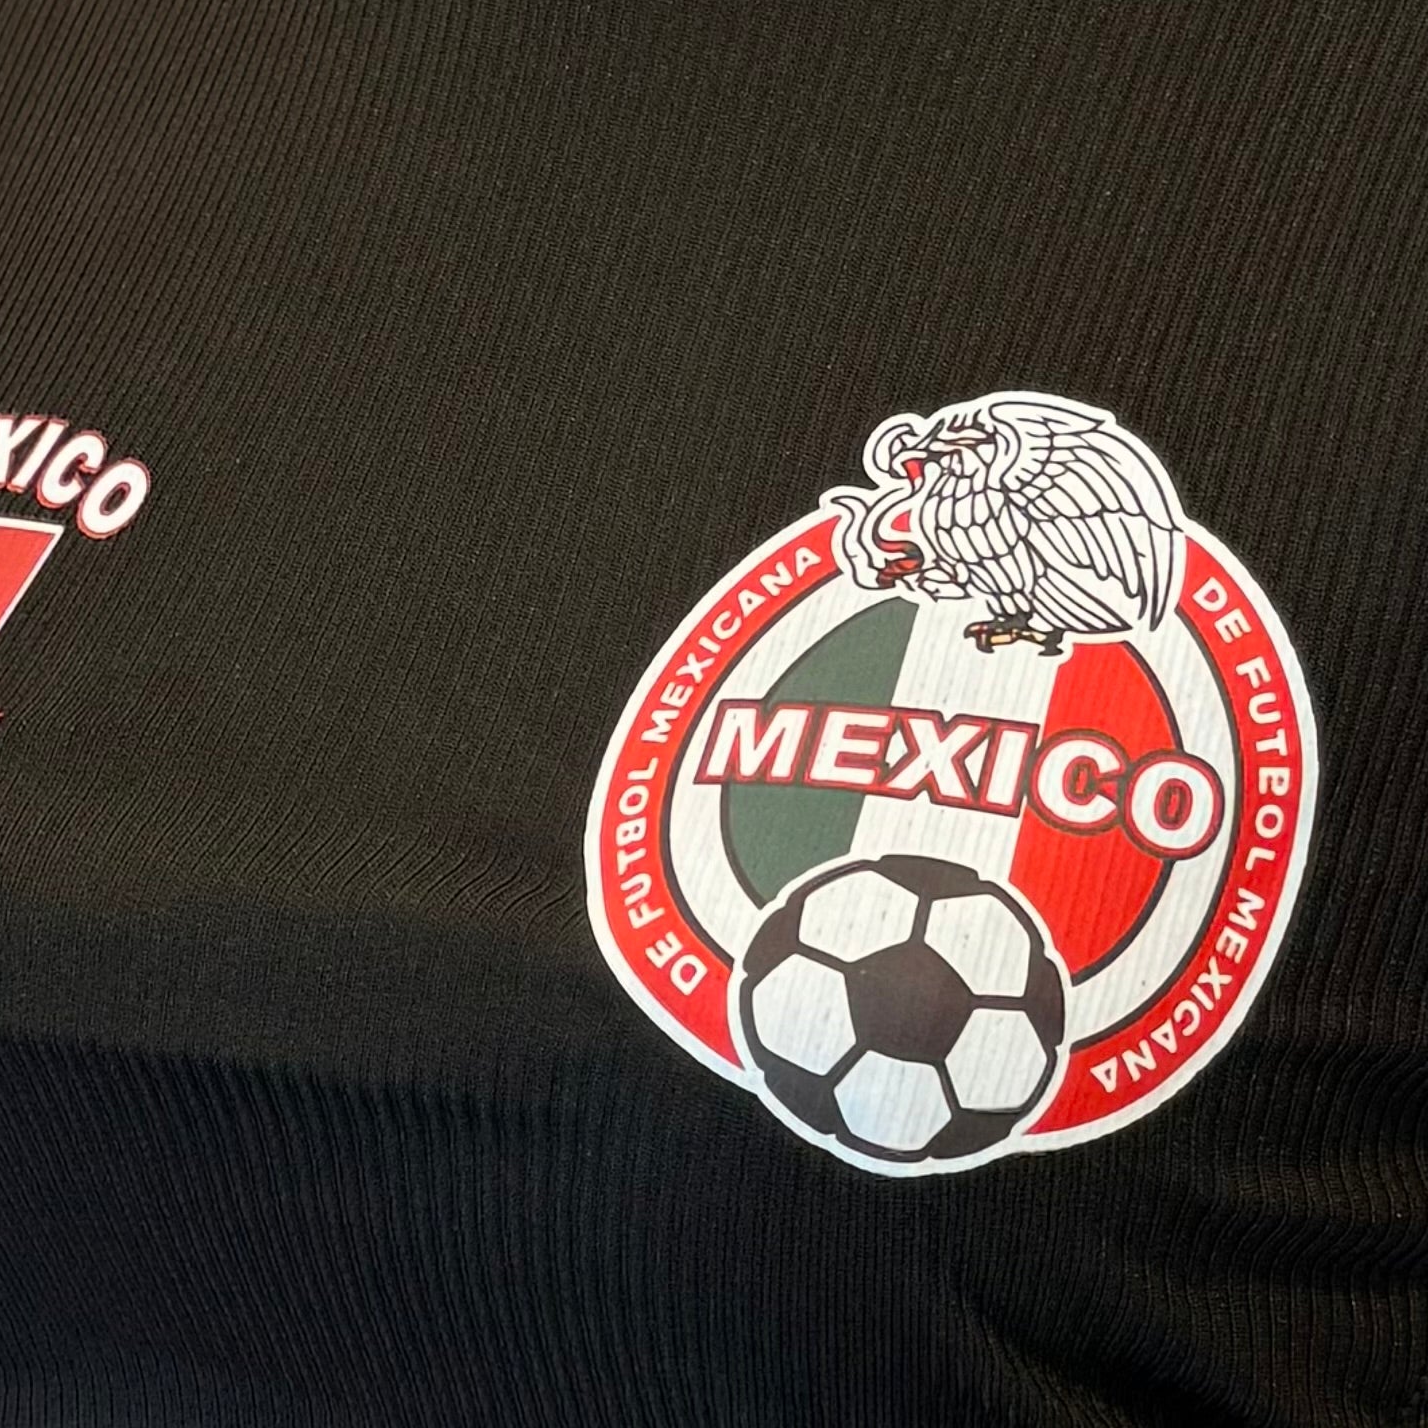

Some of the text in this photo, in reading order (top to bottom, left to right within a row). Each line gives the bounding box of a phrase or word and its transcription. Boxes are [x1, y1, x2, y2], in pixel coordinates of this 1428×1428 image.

[615, 546, 822, 996] DE FUTBOL MEXICANA
[694, 698, 1226, 861] MEXICO
[1089, 576, 1291, 1094] DE FUTBOL MEXICANA
